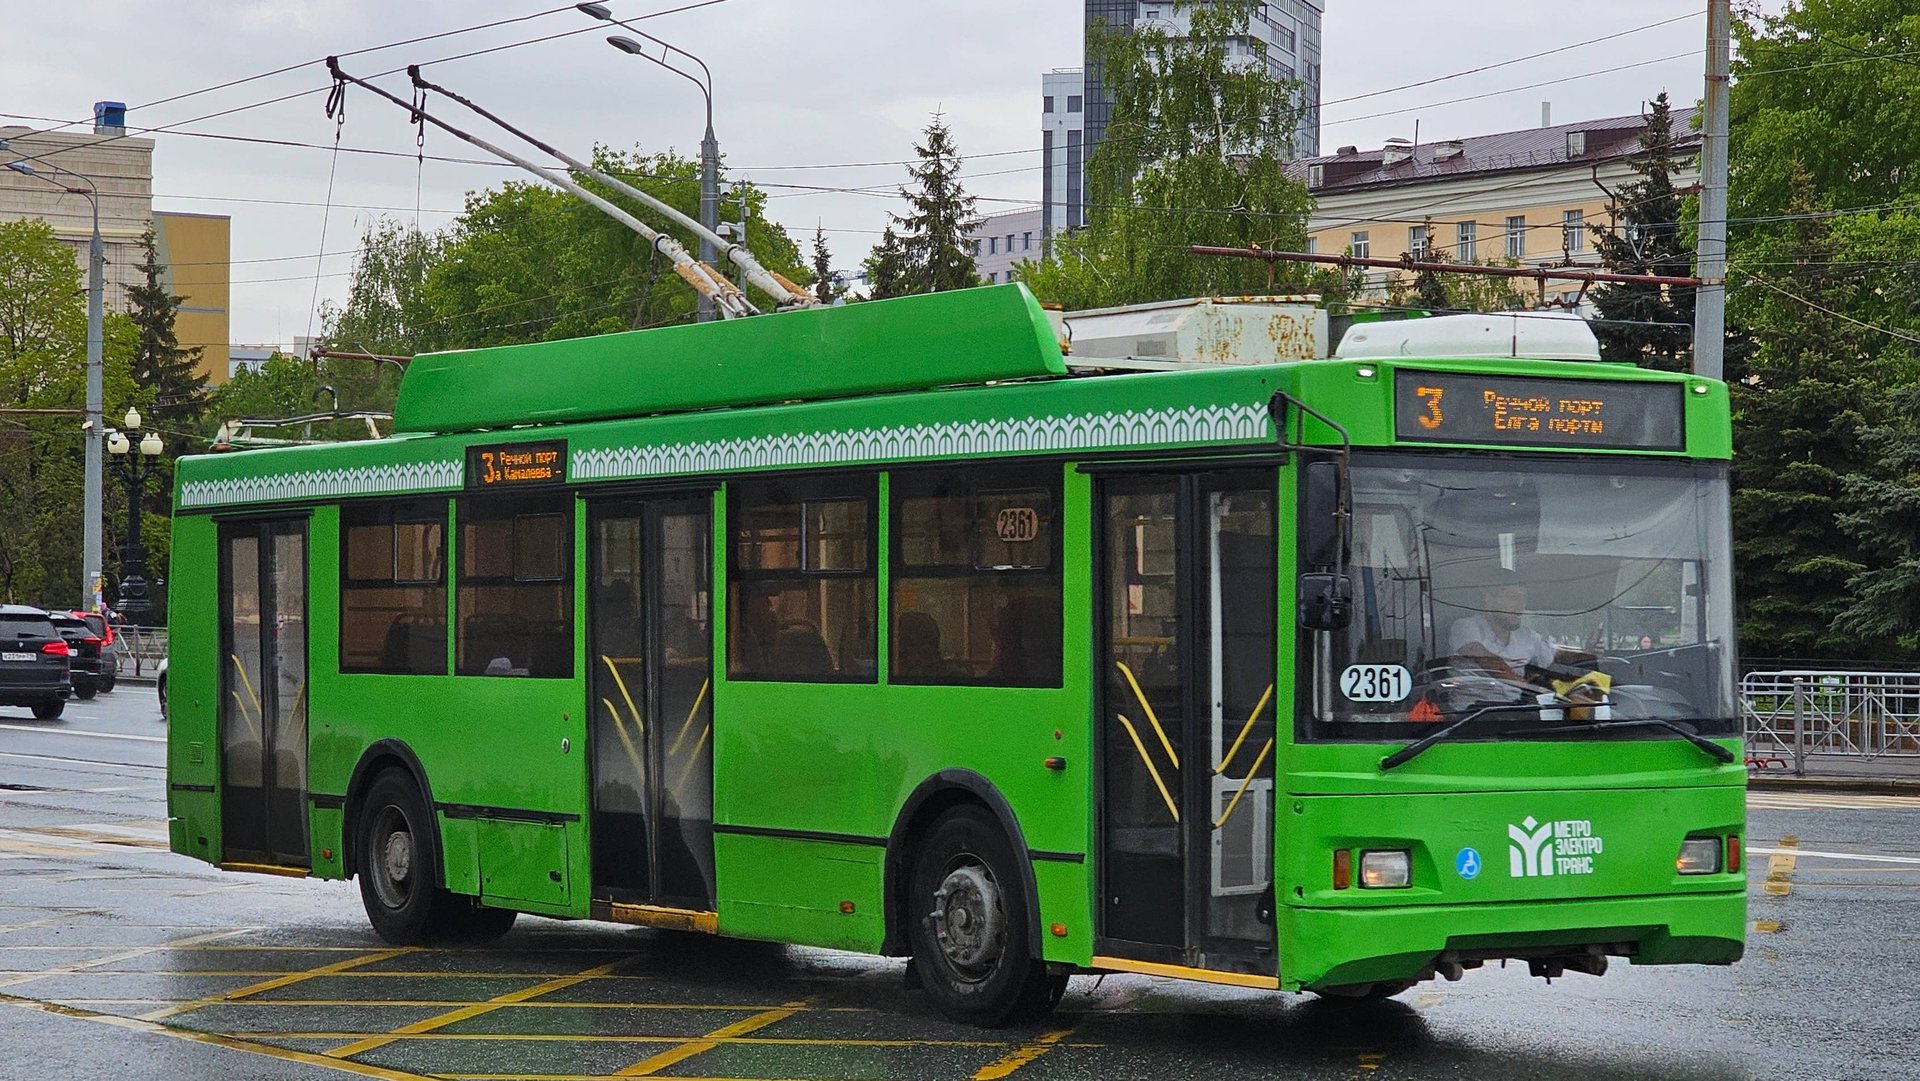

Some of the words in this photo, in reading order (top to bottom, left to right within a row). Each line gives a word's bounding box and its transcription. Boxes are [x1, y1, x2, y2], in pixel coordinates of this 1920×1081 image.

[1416, 386, 1444, 430] 3
[1559, 399, 1604, 416] порт
[500, 451, 532, 465] Речной
[535, 451, 558, 464] порт
[481, 452, 494, 484] 3
[1000, 510, 1033, 538] 2361
[1348, 667, 1401, 698] 2361
[1554, 820, 1592, 838] МЕТРО
[1555, 837, 1603, 855] ЭЛЕКТРО
[1555, 857, 1594, 875] ТРАНС
